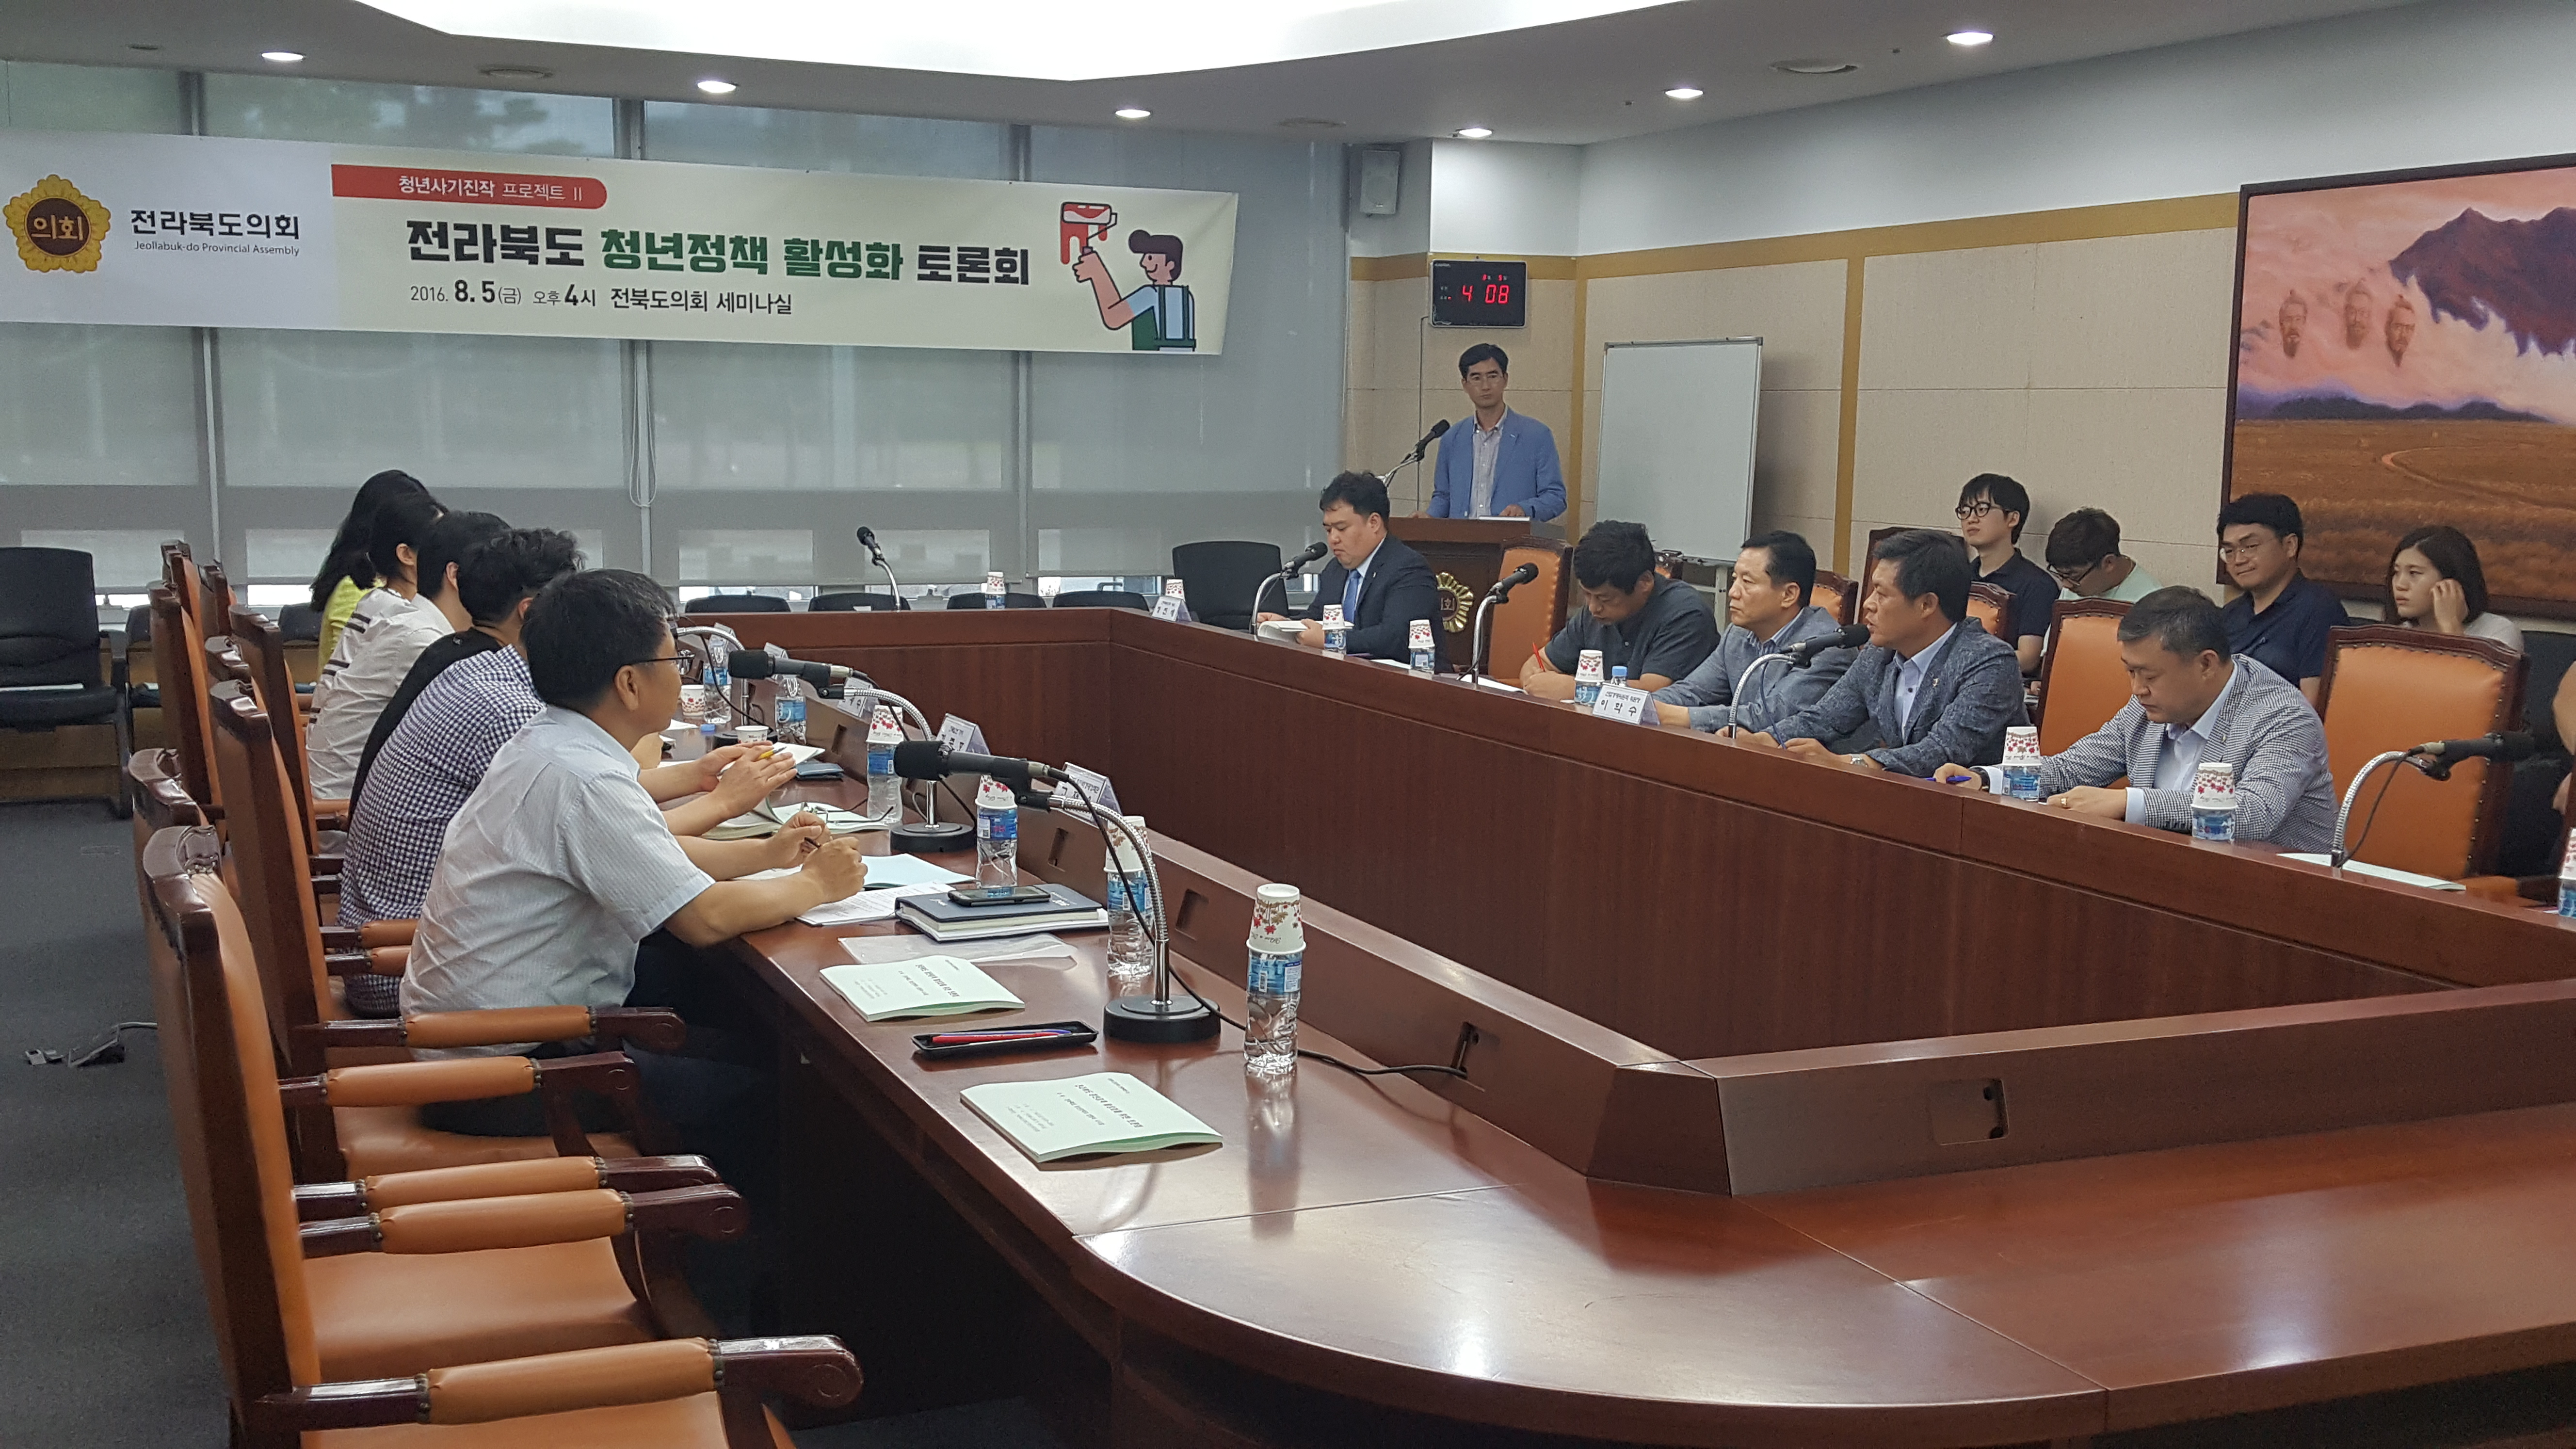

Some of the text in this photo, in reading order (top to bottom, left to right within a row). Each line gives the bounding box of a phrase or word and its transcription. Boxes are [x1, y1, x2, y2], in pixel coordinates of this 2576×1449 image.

[399, 175, 496, 198] 청년사기진작
[502, 183, 566, 201] 프로젝트
[31, 215, 84, 242] 의회
[131, 209, 299, 240] 전라북도의회
[135, 241, 299, 257] Jeollabuk-do Provincial Assembly
[406, 220, 1029, 285] 전라북도 청년정책 활성화 토론회
[611, 288, 708, 312] 전북도의회
[716, 291, 792, 315] 세미나실
[1463, 284, 1509, 304] 4 08
